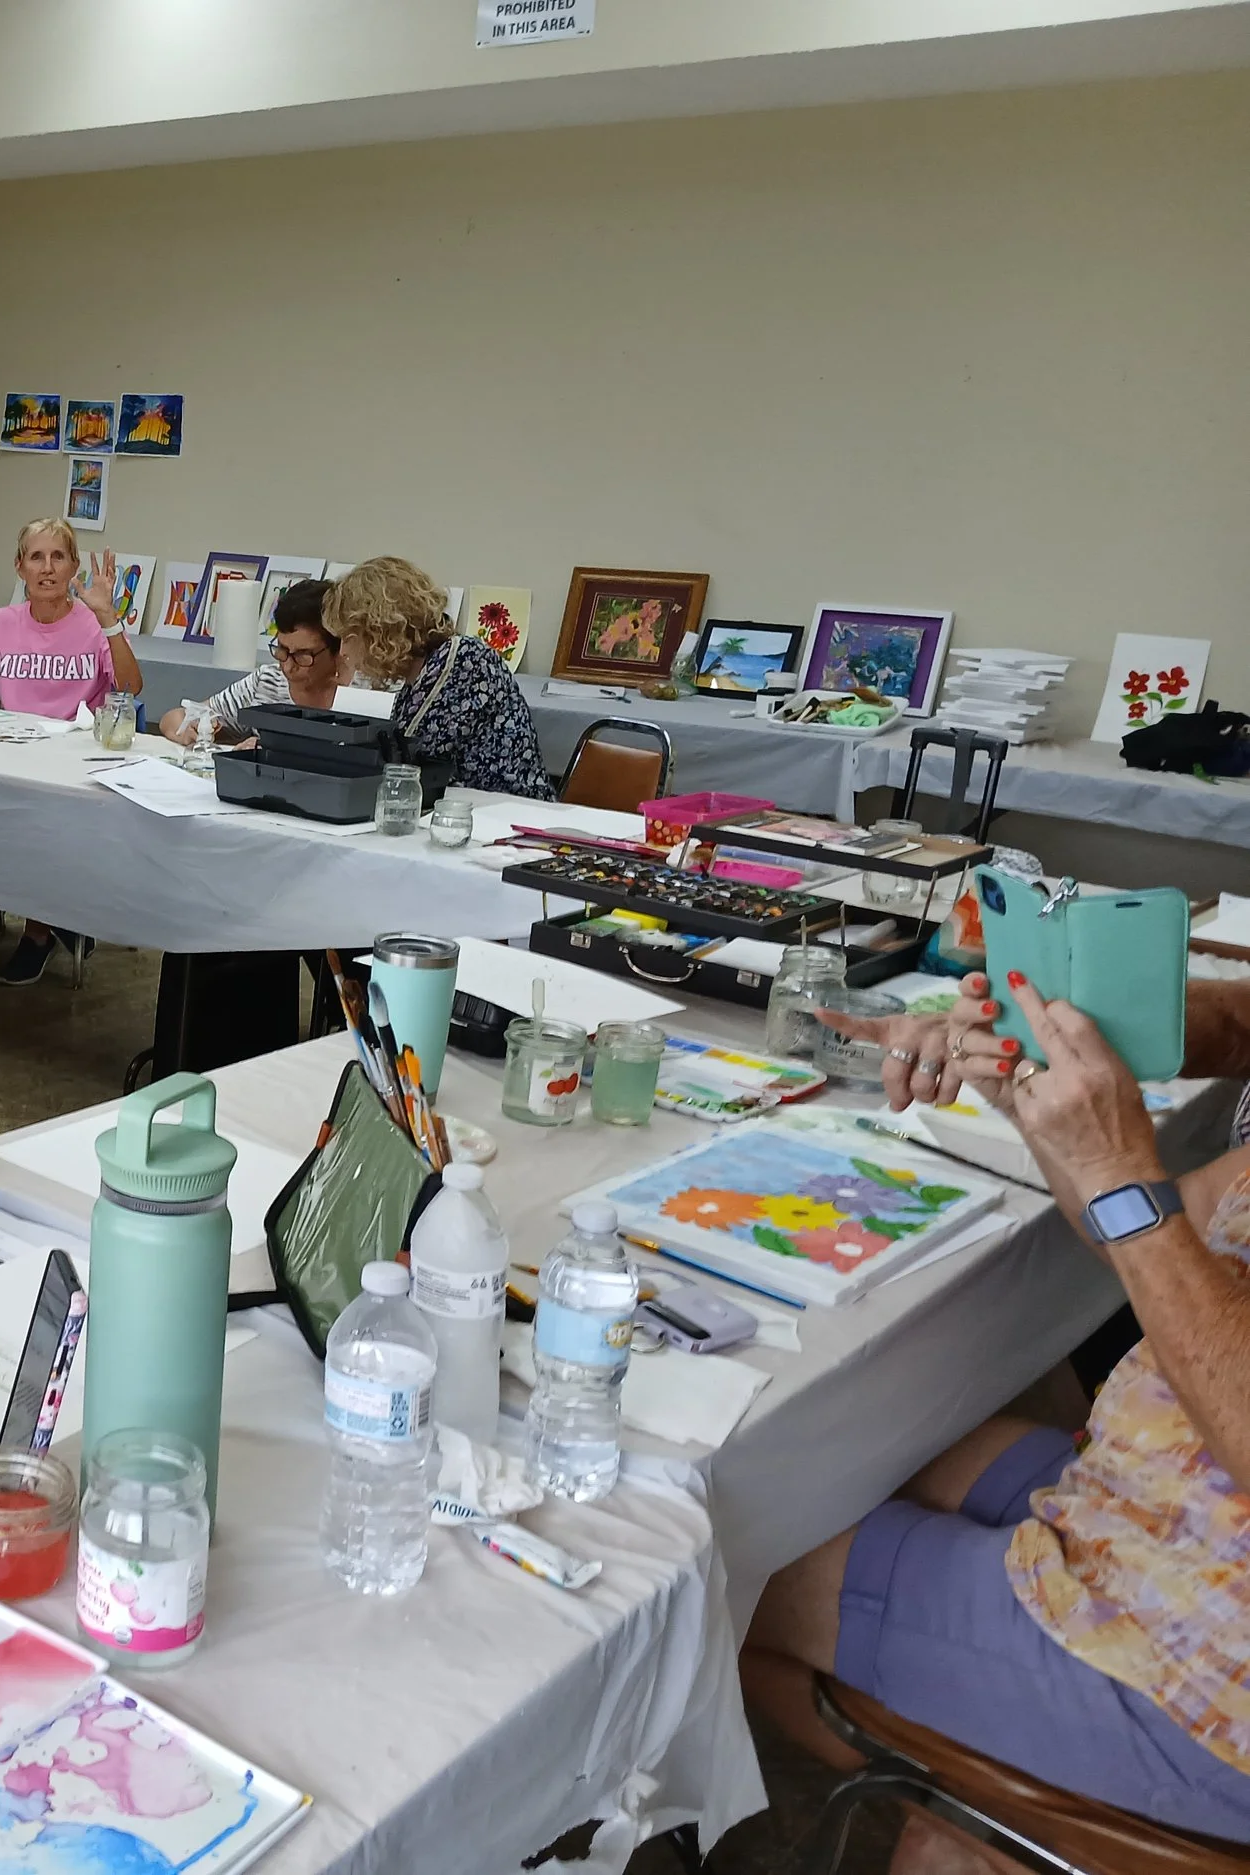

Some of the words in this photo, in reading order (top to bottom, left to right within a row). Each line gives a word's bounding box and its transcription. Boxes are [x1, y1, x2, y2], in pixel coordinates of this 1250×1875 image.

[496, 0, 576, 18] PROHIBITED
[492, 24, 506, 38] IN
[508, 19, 538, 36] THIS
[540, 16, 576, 32] AREA
